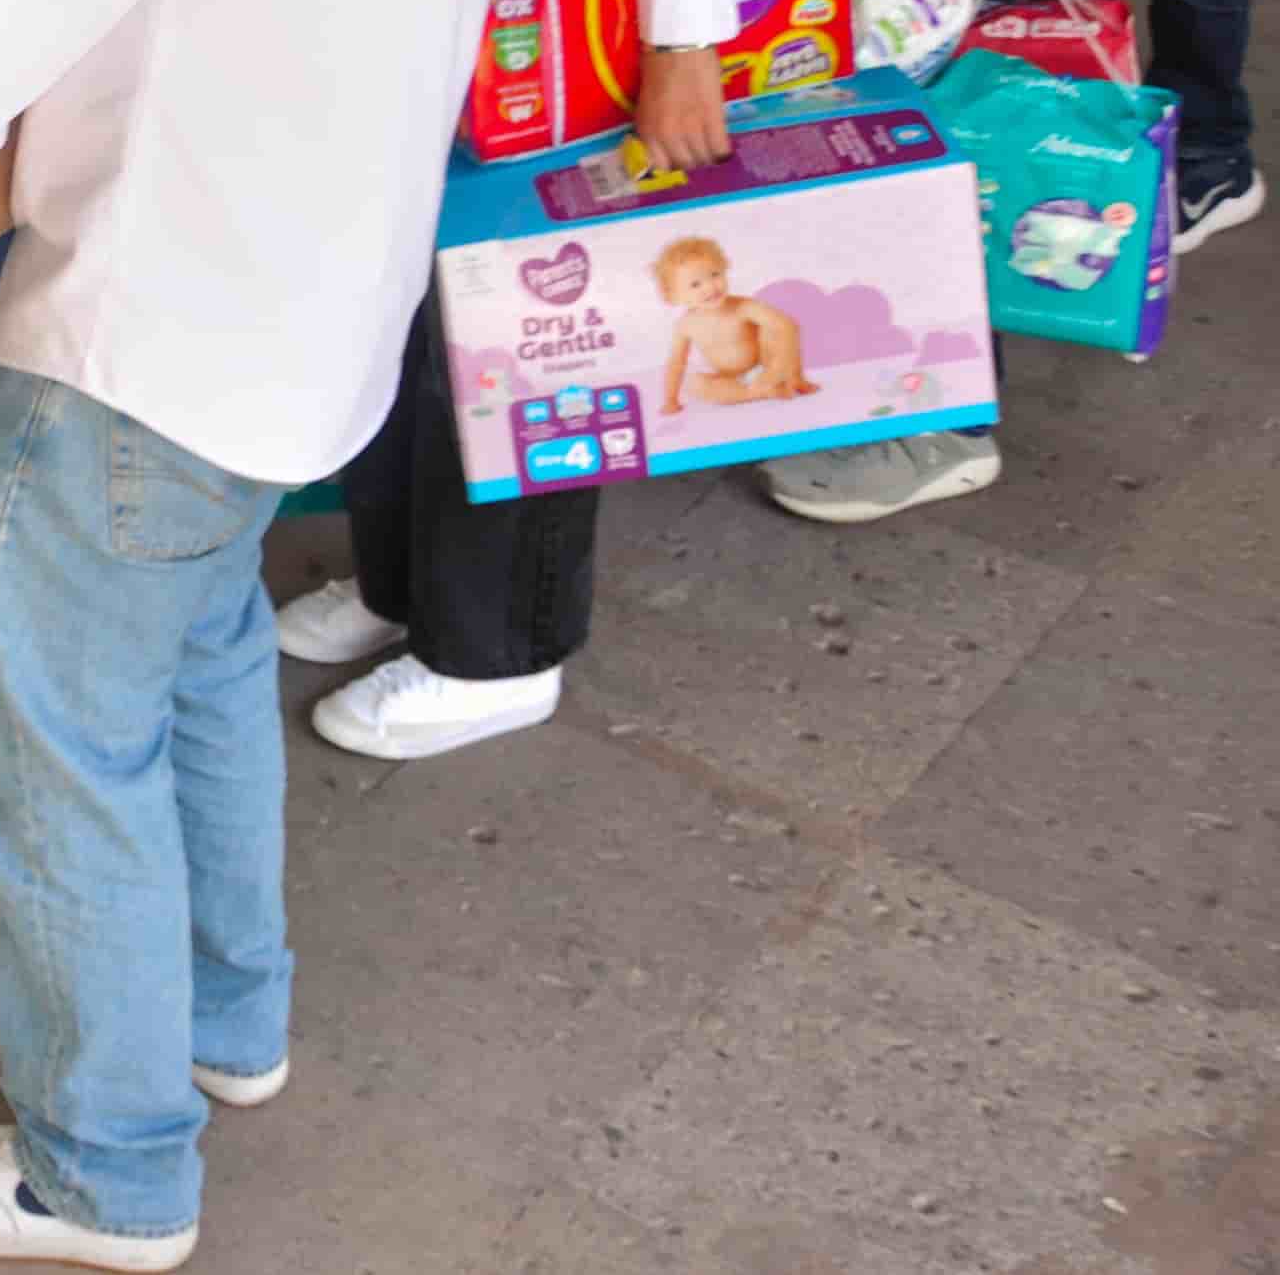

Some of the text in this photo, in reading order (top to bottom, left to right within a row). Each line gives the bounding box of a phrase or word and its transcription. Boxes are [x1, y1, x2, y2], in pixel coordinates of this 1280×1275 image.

[521, 308, 604, 337] Dry &
[517, 330, 615, 360] Gentle
[564, 440, 593, 470] 4
